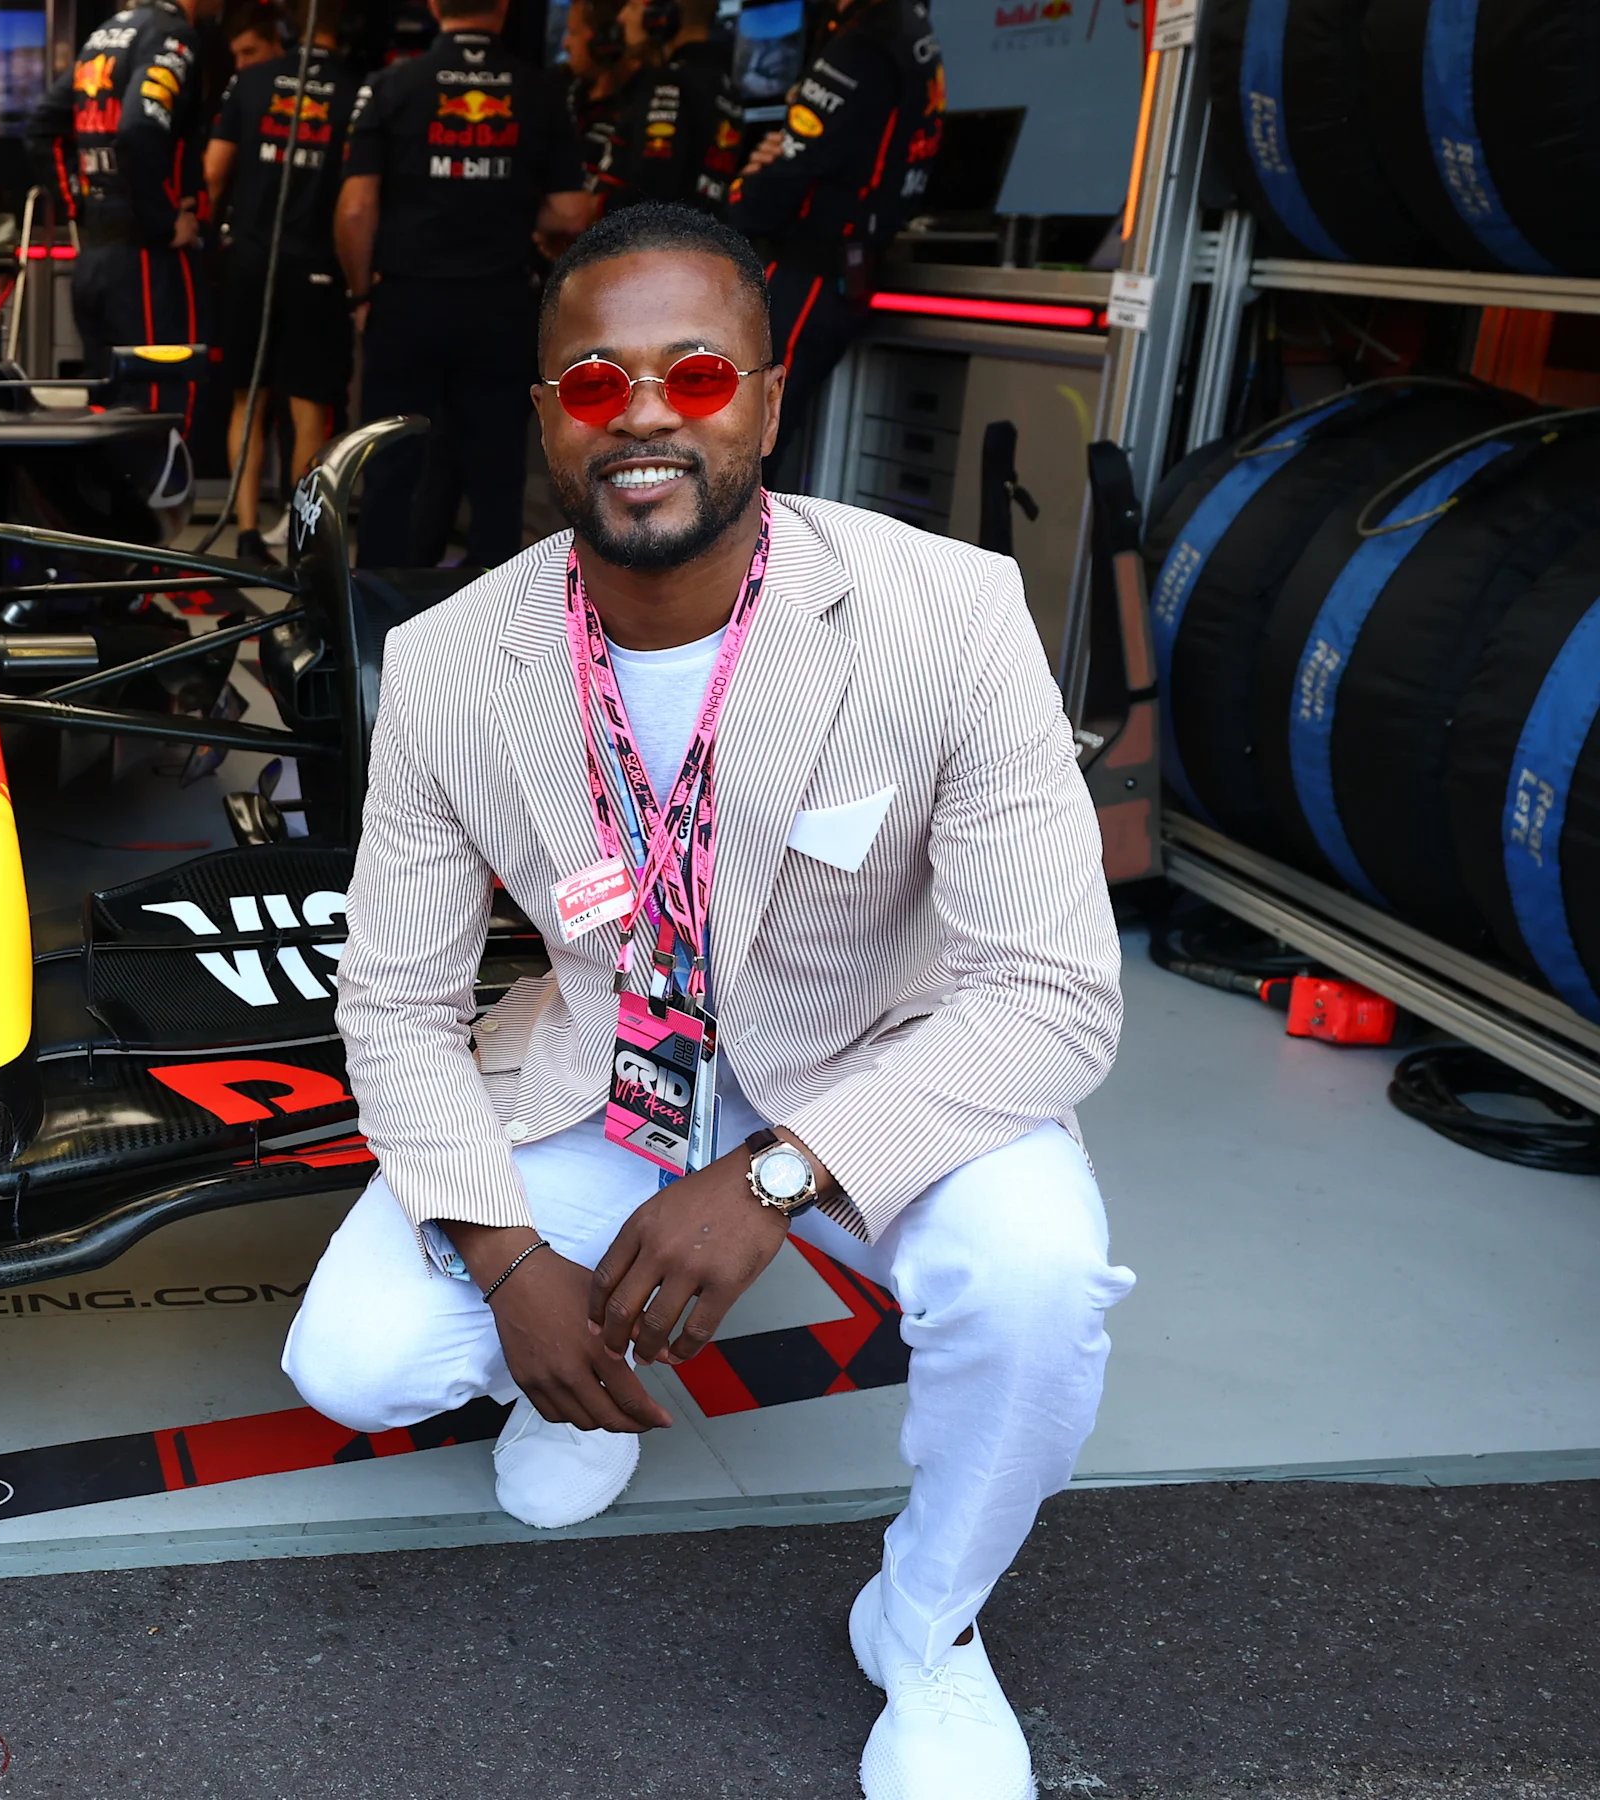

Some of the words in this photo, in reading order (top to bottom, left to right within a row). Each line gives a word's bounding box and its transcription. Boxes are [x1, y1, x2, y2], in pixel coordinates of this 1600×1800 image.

[437, 70, 512, 85] ORACLE
[428, 121, 473, 146] Red
[476, 122, 520, 147] Bull
[430, 157, 490, 178] Mobil
[748, 553, 765, 582] VIP
[1155, 541, 1192, 617] Right
[590, 637, 604, 662] VIP
[700, 677, 728, 732] MONACO
[740, 609, 751, 628] 2025
[1299, 638, 1329, 721] Right
[1314, 647, 1341, 722] Rear
[623, 752, 648, 789] 2025
[670, 780, 690, 807] VIP
[698, 800, 711, 826] VIP
[1511, 767, 1538, 844] Left
[1527, 779, 1555, 868] Rear
[565, 889, 586, 908] PIT
[587, 873, 625, 897] LANE
[141, 891, 348, 1007] VIS
[615, 1050, 691, 1107] GRID
[615, 1073, 647, 1105] VIP
[644, 1090, 685, 1125] Access
